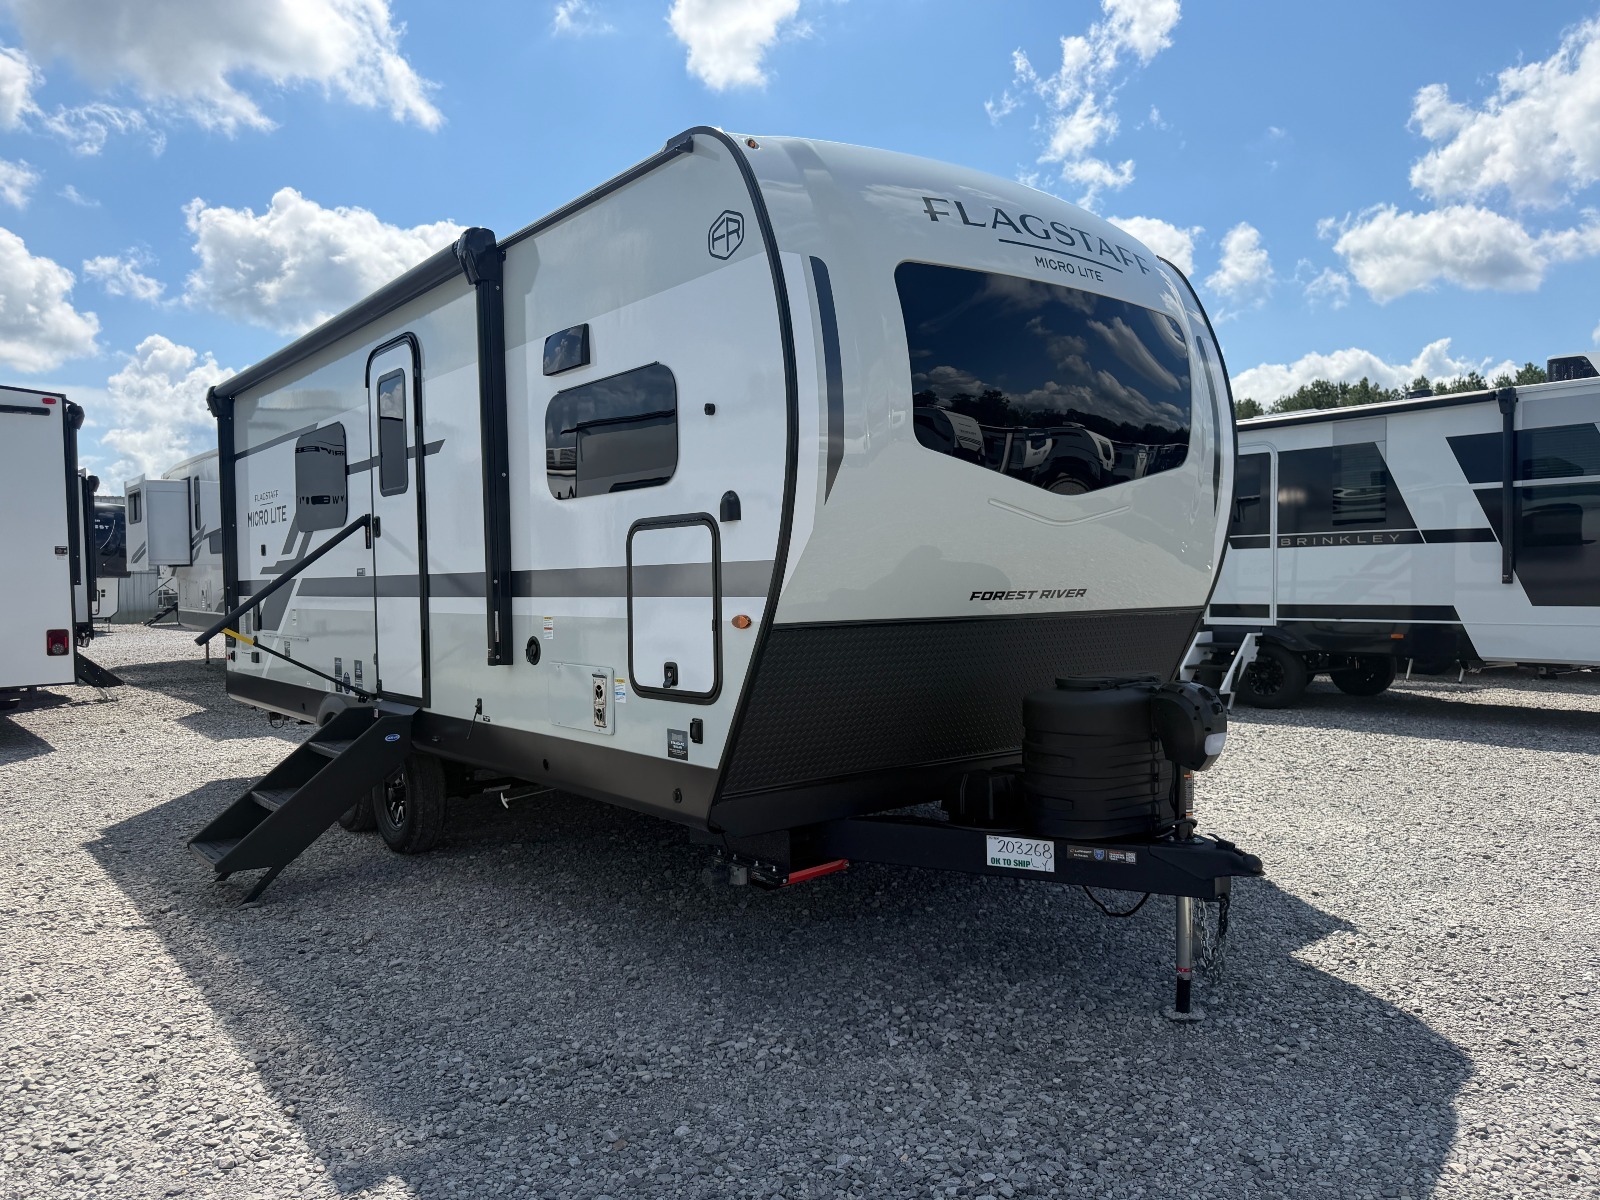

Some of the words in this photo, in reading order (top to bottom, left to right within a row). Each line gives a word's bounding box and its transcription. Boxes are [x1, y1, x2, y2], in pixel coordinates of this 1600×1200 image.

[922, 196, 1150, 275] FLAGSTAFF
[1034, 255, 1075, 275] MICRO
[1078, 266, 1104, 282] LITE
[247, 509, 269, 528] MICRO
[270, 505, 287, 523] LITE
[1280, 534, 1400, 546] BRINKLEY
[969, 590, 1038, 601] FOREST
[1039, 588, 1087, 600] RIVER
[997, 839, 1053, 860] 203268
[990, 857, 1001, 865] OK
[1002, 858, 1012, 867] TO
[1013, 859, 1031, 868] SHIP
